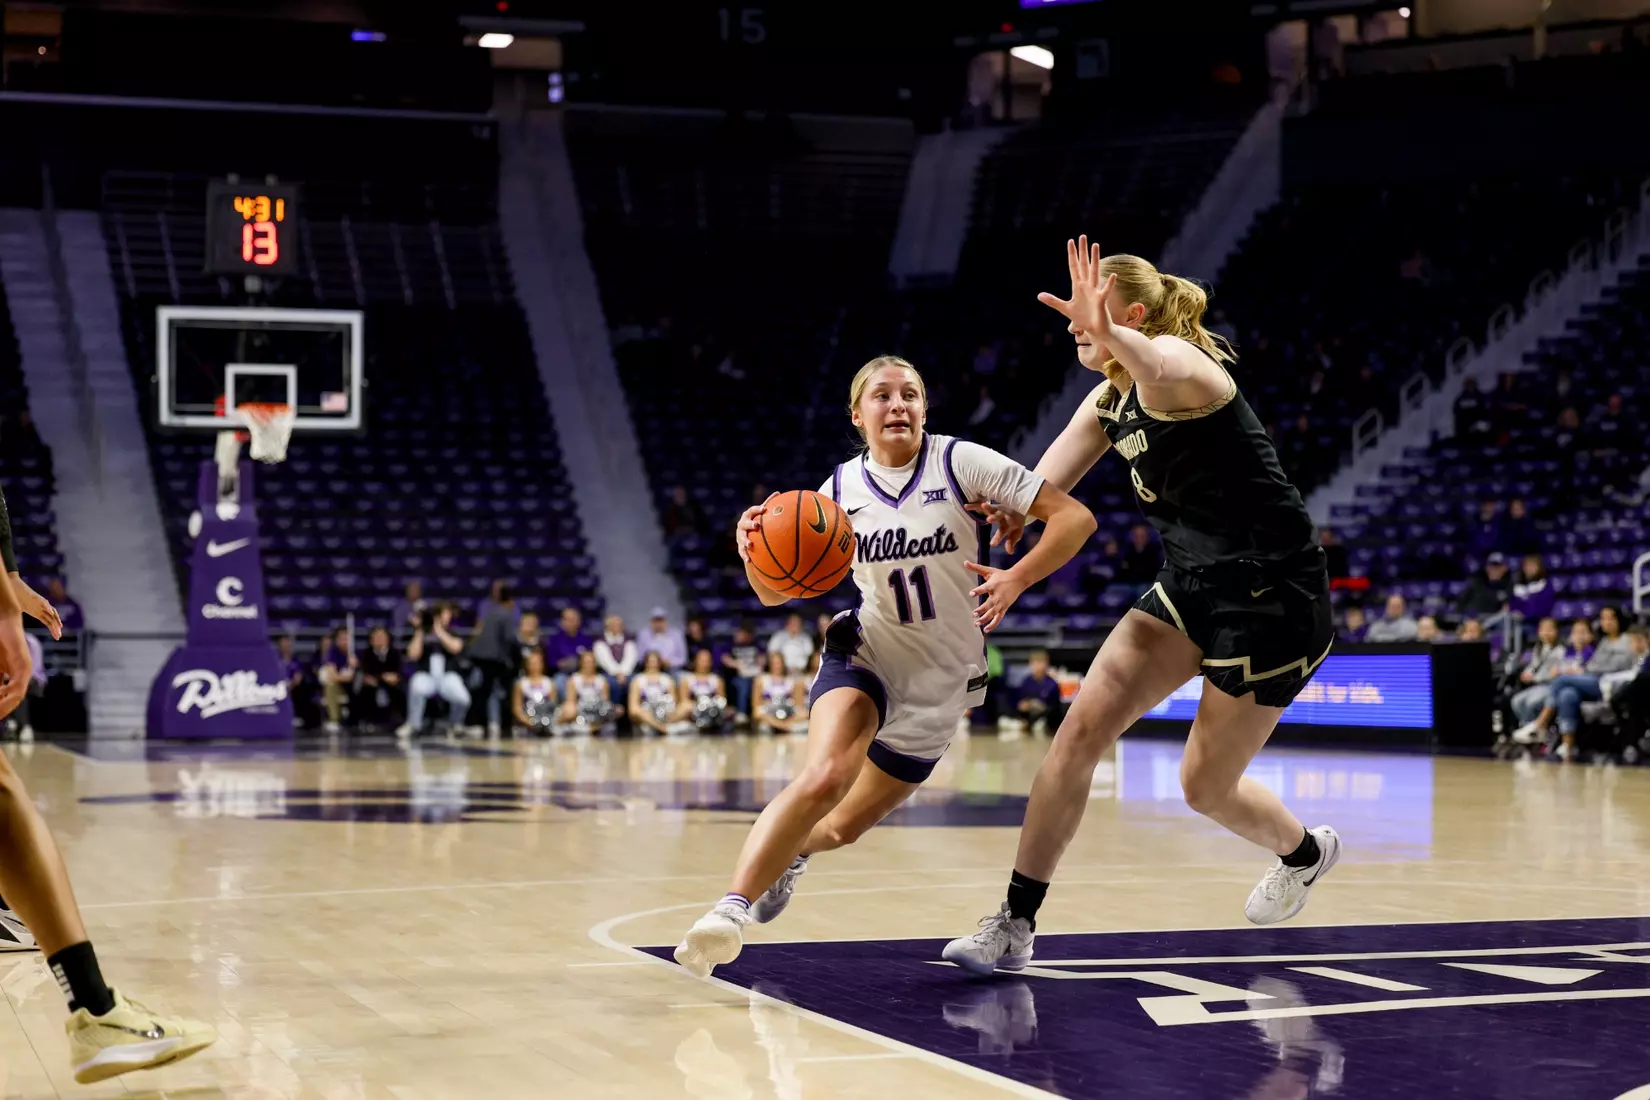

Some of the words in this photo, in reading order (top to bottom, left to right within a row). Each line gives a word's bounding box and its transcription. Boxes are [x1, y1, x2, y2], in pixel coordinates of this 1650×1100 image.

[718, 7, 767, 44] 15
[233, 195, 285, 222] 4:31
[242, 221, 279, 265] 13
[922, 487, 948, 504] XII
[1130, 467, 1158, 503] 8
[855, 523, 959, 563] Wildcats
[887, 564, 936, 624] 11
